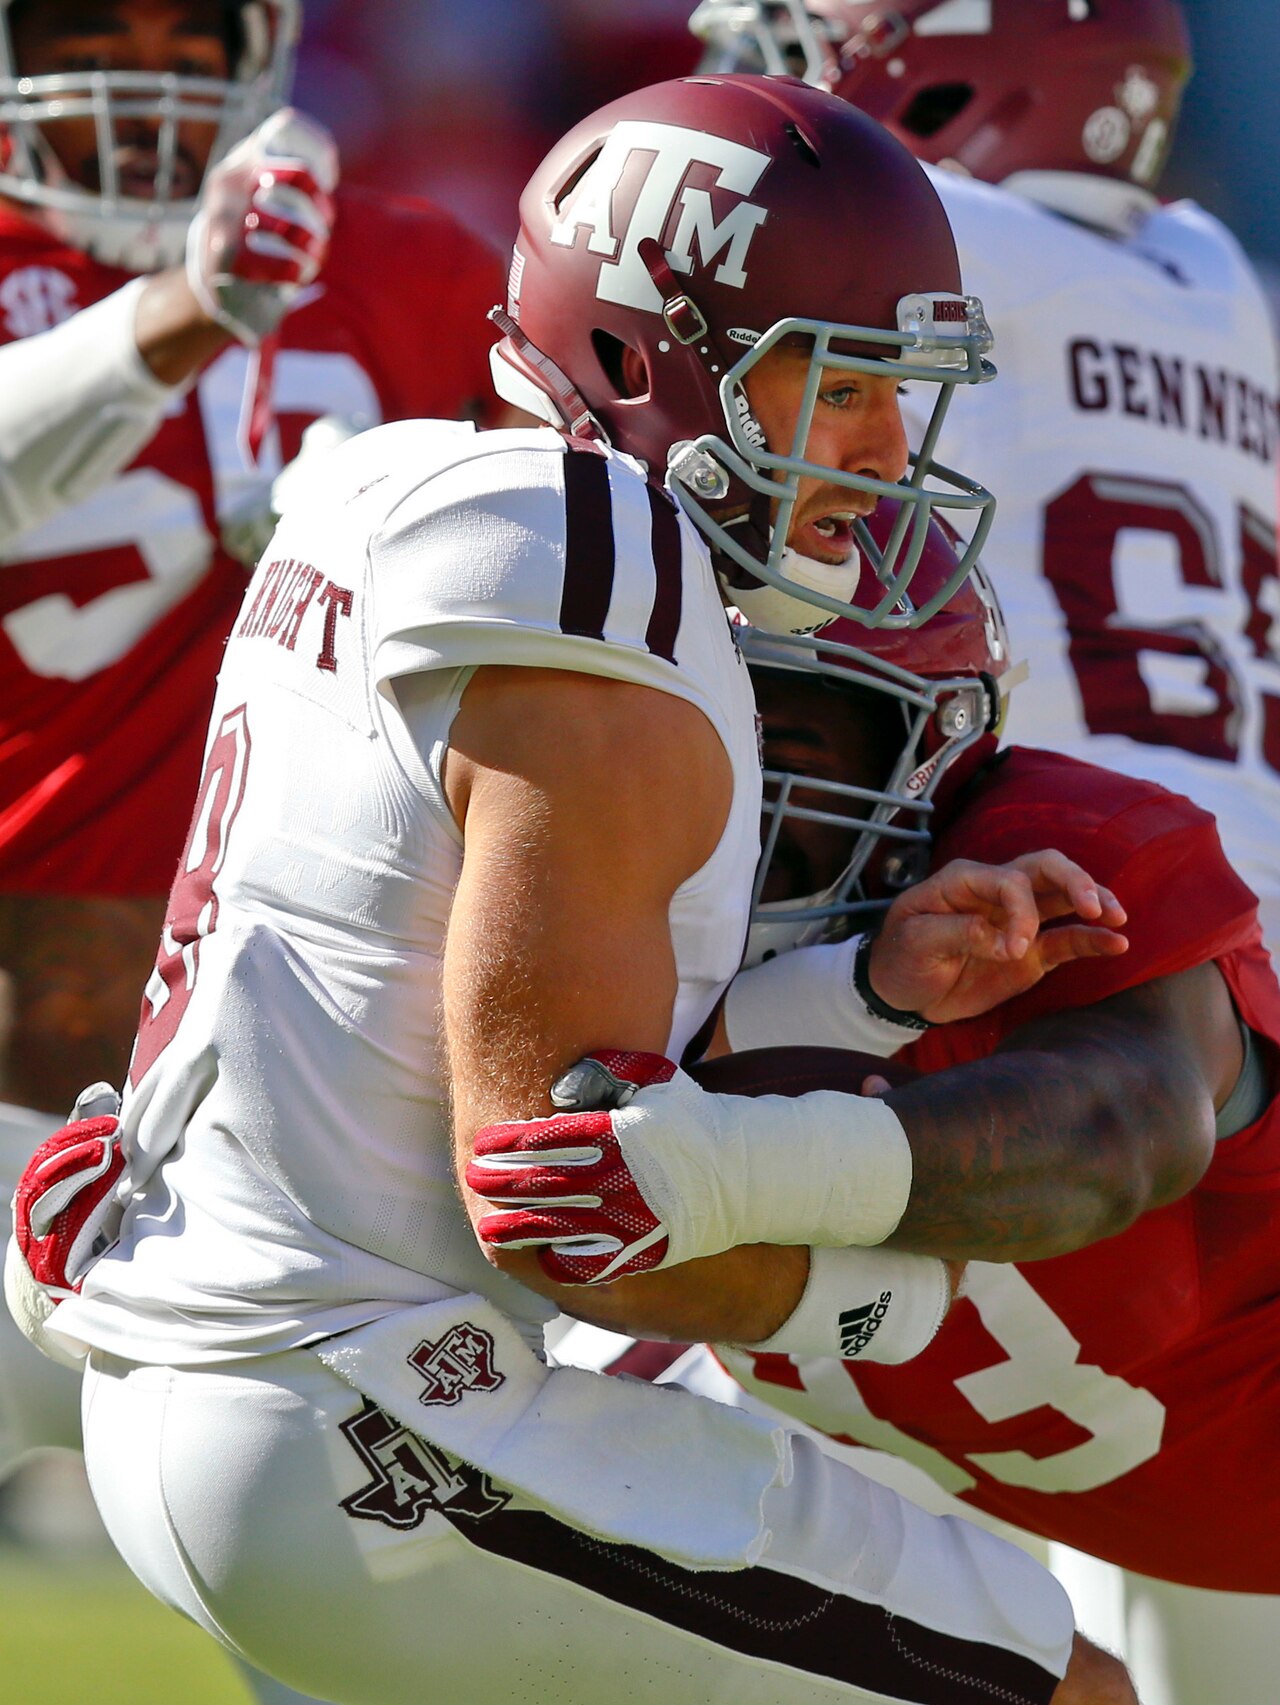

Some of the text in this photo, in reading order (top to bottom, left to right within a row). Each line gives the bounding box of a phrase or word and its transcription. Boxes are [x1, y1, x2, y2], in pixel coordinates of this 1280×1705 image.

[729, 329, 761, 345] Ridde
[735, 395, 766, 452] Ridd
[237, 558, 354, 674] KNIGHT
[844, 1290, 892, 1357] adidas
[370, 1428, 467, 1507] AT
